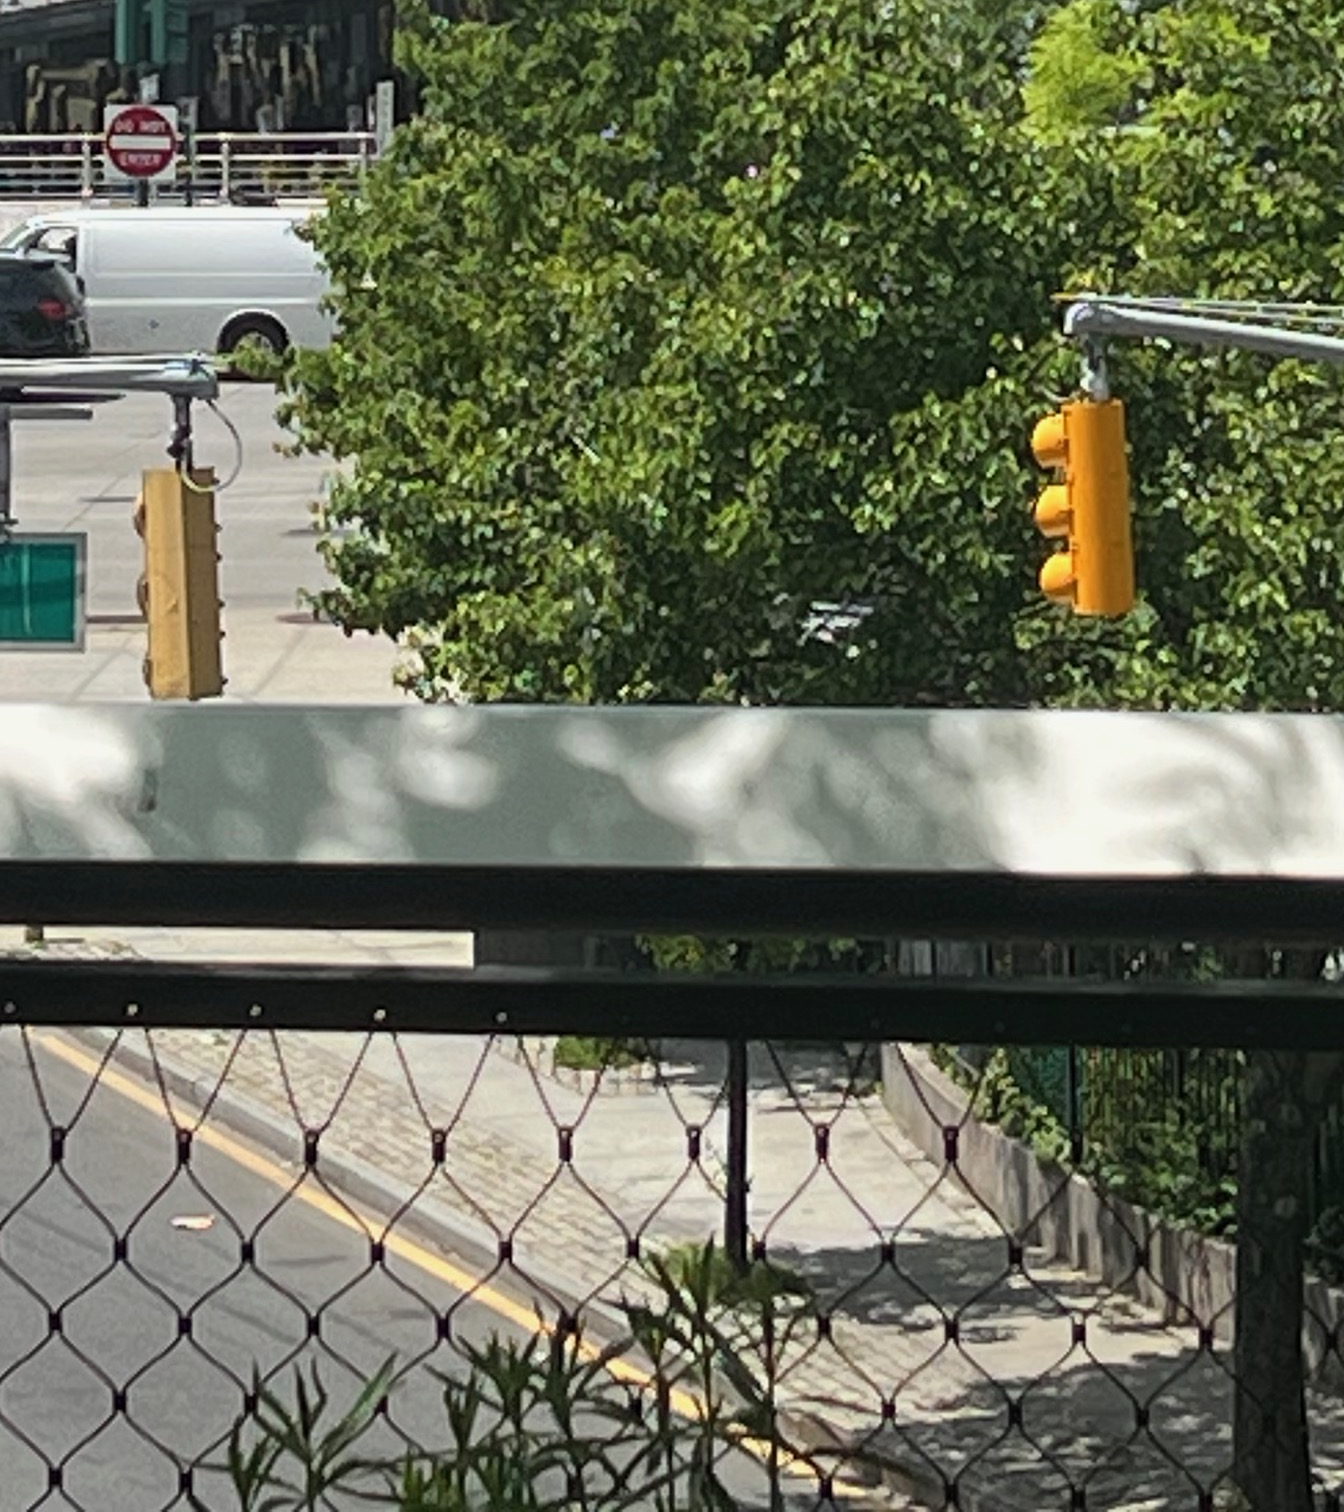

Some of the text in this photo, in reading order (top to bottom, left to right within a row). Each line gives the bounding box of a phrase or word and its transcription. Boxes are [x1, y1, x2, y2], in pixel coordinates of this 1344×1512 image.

[114, 120, 166, 133] DO NOT
[119, 152, 162, 166] ENTER
